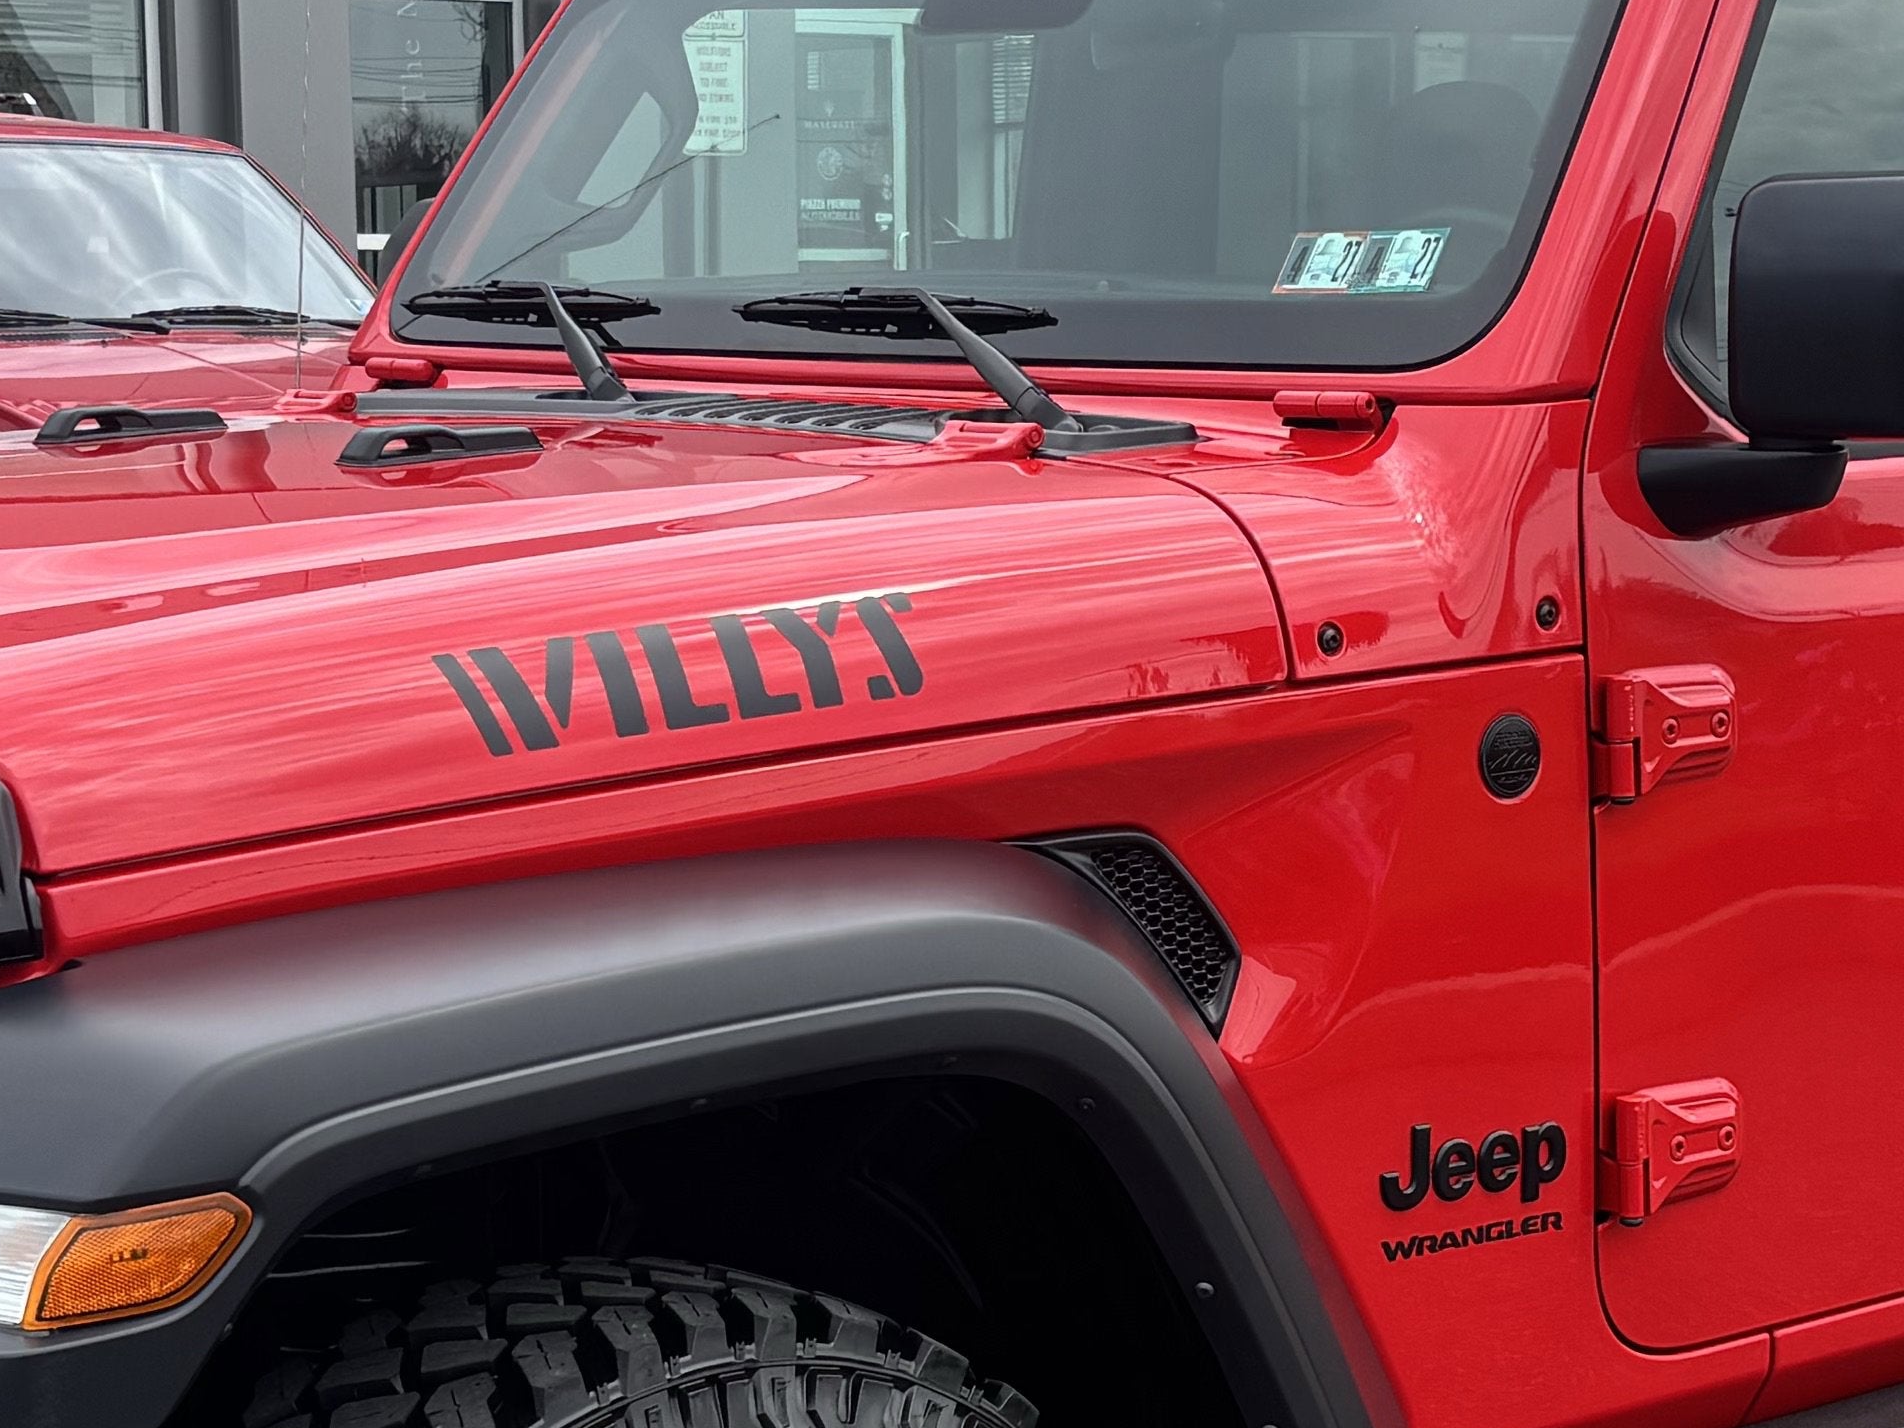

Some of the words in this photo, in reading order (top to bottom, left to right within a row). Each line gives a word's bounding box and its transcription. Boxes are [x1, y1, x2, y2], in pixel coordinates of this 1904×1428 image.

[400, 37, 428, 113] The
[1410, 236, 1442, 283] 27
[432, 592, 924, 757] WILLYS
[1379, 1120, 1567, 1212] Jeep
[1380, 1211, 1564, 1263] WRANGLER
